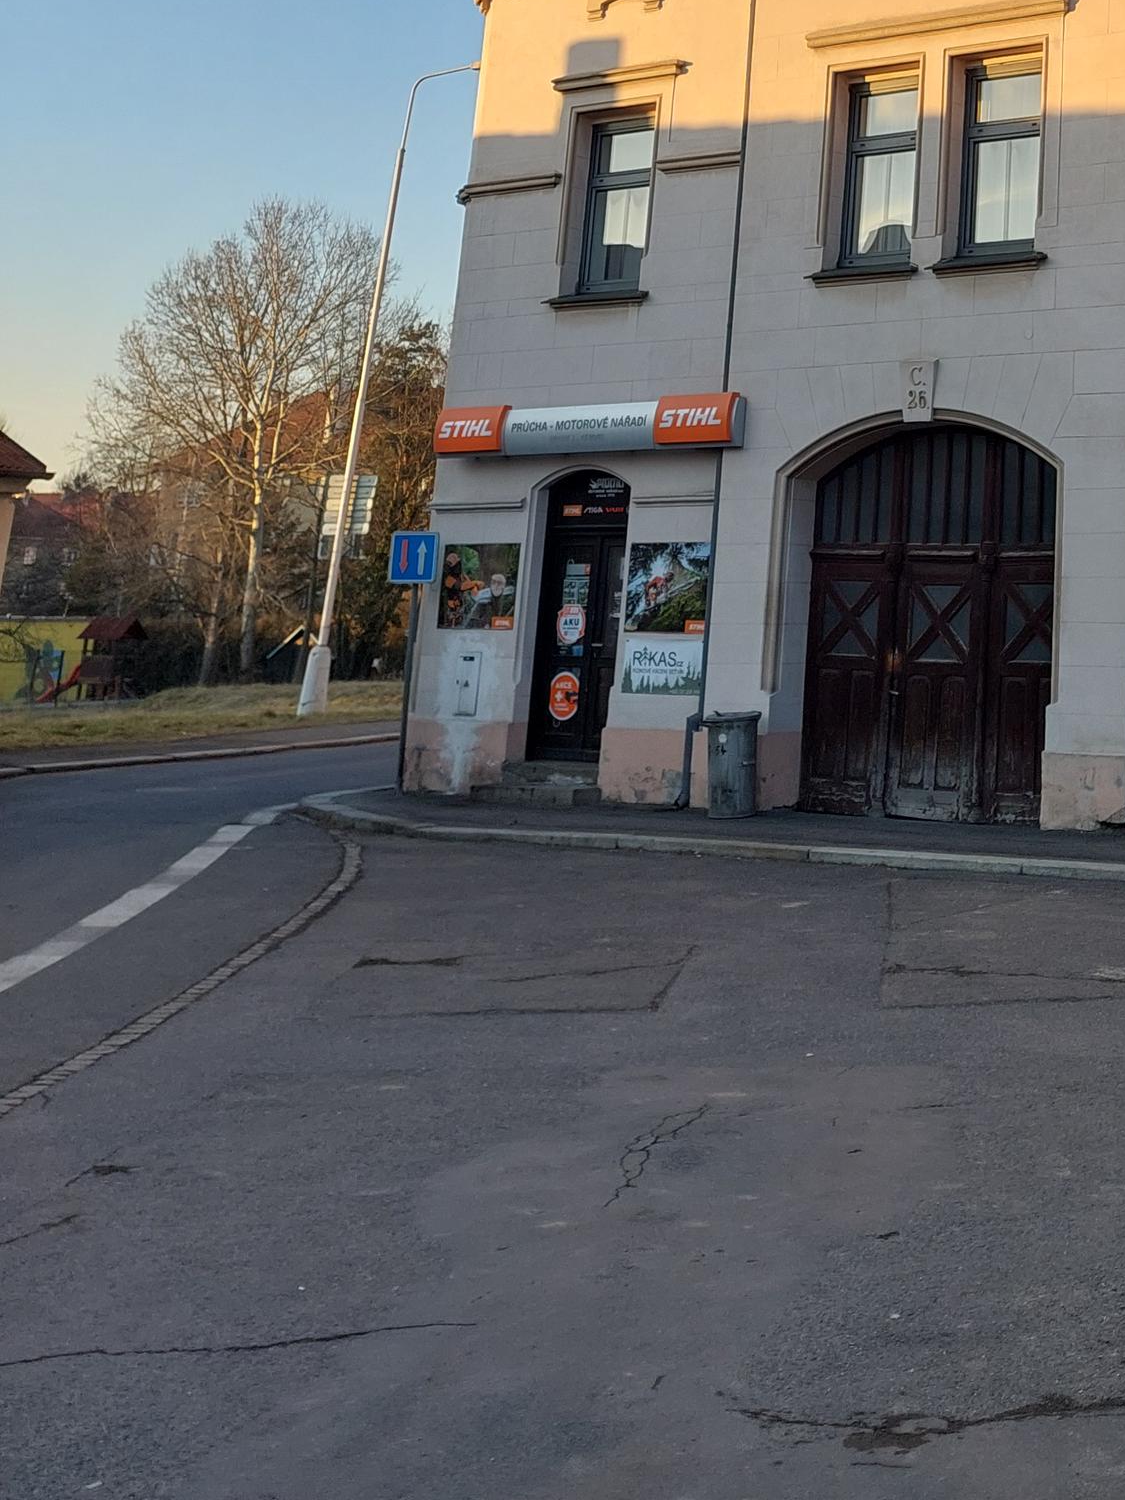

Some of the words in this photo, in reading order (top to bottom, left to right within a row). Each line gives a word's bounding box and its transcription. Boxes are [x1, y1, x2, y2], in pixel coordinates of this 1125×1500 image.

[555, 415, 608, 431] MOTOROVÉ
[610, 412, 648, 427] NÁŘADÍ
[658, 406, 722, 428] STIHL
[438, 418, 493, 439] STIHL
[563, 617, 580, 626] AKU
